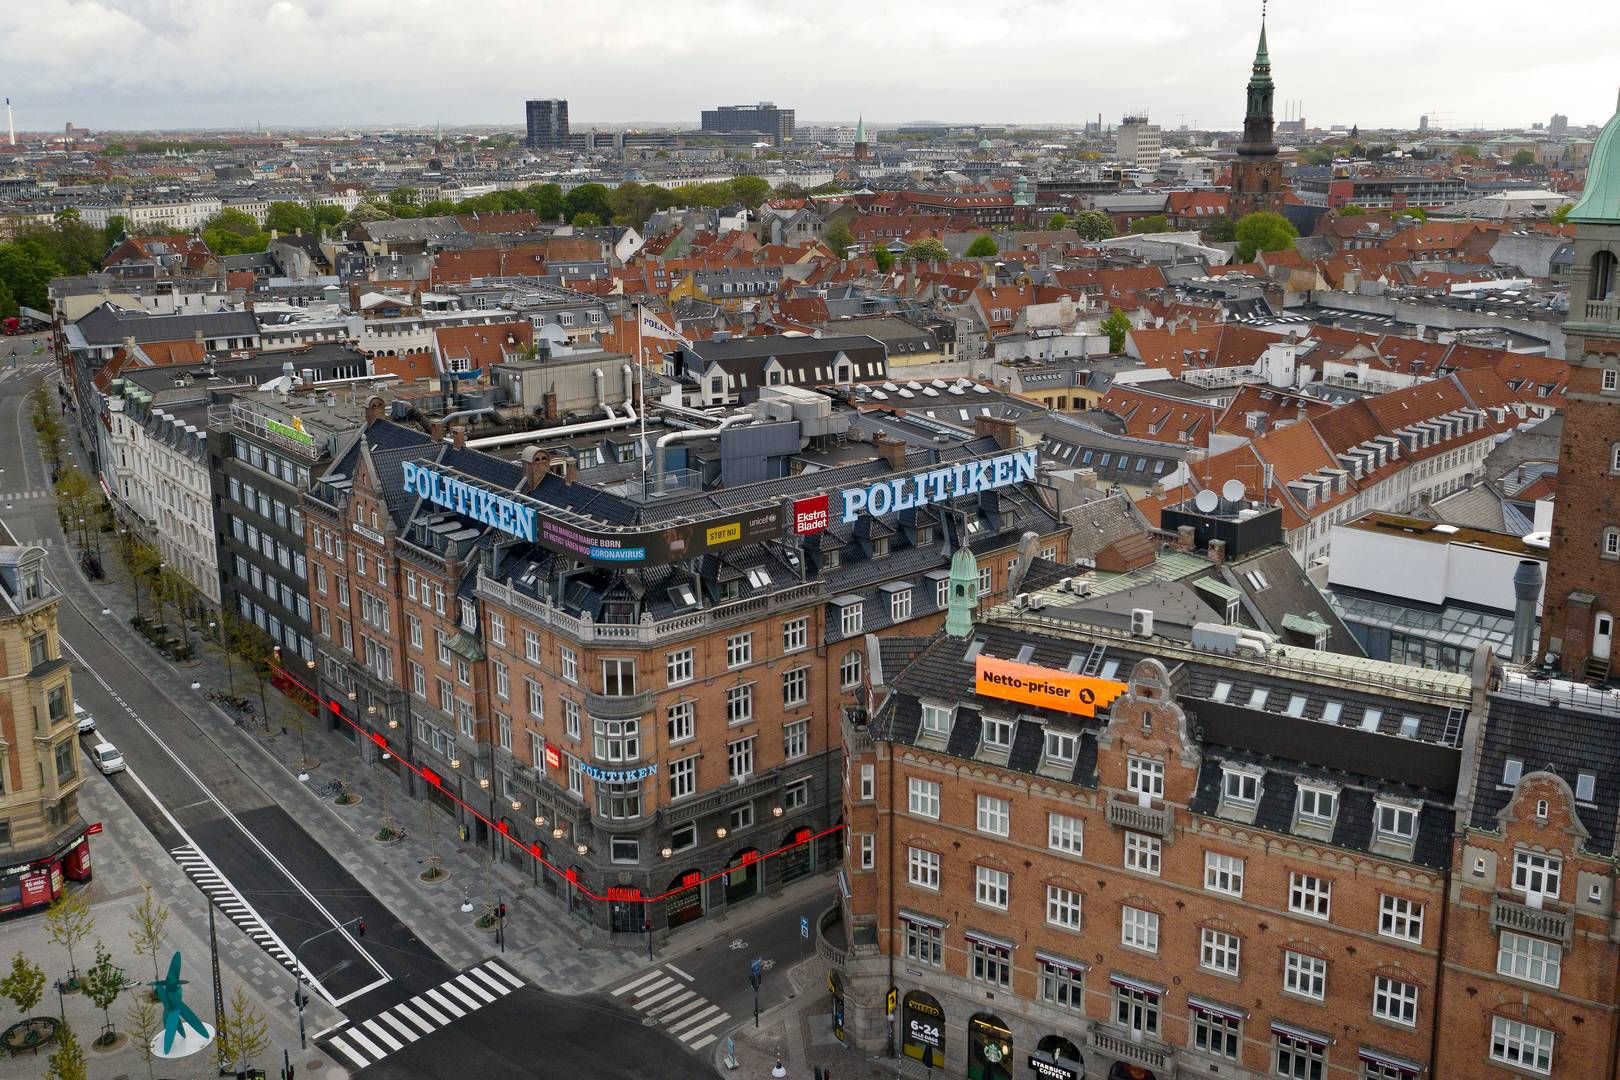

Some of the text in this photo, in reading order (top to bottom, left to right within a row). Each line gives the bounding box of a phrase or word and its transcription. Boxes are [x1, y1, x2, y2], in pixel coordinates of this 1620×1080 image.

[842, 450, 1037, 523] POLITIKEN
[402, 461, 537, 543] POLITIKEN
[749, 513, 769, 527] unicef
[797, 510, 827, 523] Ekstra
[797, 519, 827, 532] Bladet
[579, 534, 599, 546] MANGE
[600, 539, 621, 548] BØRN
[710, 528, 737, 541] STØT NU
[591, 548, 643, 559] CORONAVIRUS
[983, 671, 1071, 698] Netto-priser
[580, 762, 657, 781] POLITIKEN
[910, 1020, 939, 1037] 6-24
[1032, 1060, 1071, 1078] STARBUCKS
[1039, 1068, 1064, 1080] COFFEE
